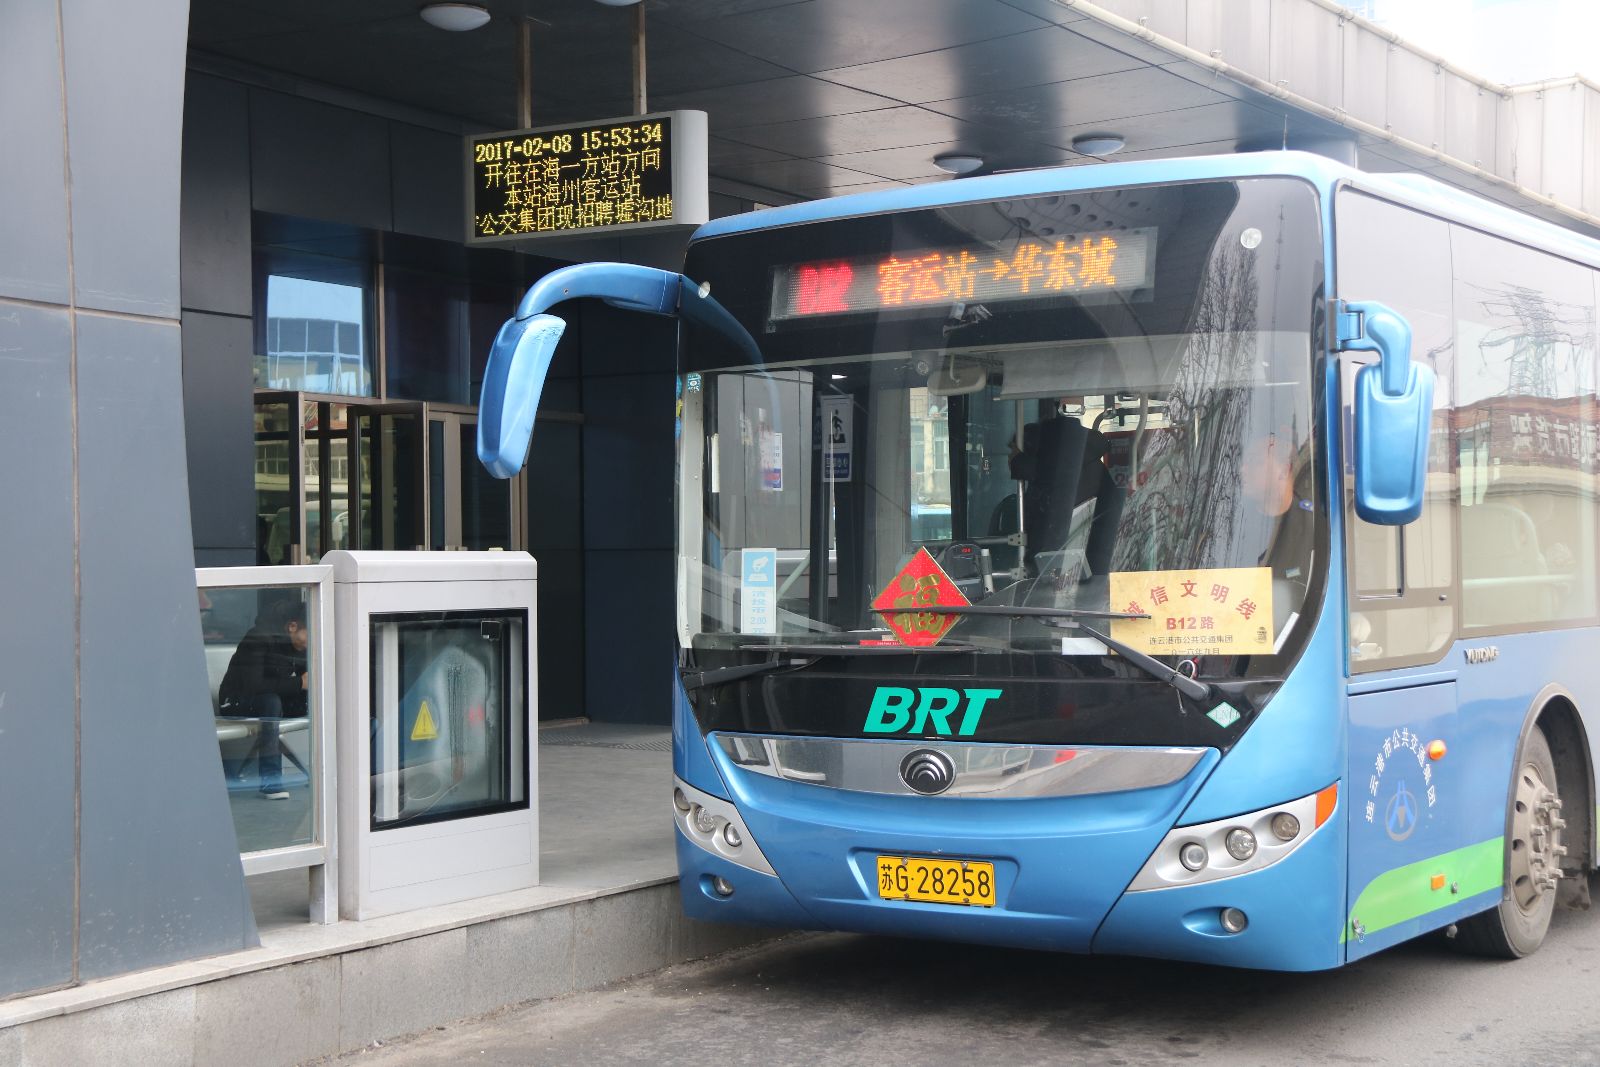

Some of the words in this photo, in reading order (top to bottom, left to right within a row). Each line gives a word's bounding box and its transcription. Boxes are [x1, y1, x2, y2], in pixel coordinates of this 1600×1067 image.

[475, 134, 572, 163] 2017-02-08
[581, 123, 662, 151] 15:53:34
[484, 146, 661, 188] 开往在海一方站方向
[504, 170, 641, 209] 本站海州客运站
[475, 194, 673, 236] 公交集团现招聘墟沟地
[893, 573, 946, 635] 福
[1122, 580, 1257, 622] 诚信文明线
[1150, 635, 1233, 645] 连云港市公共交通集团
[863, 686, 1003, 736] BRT
